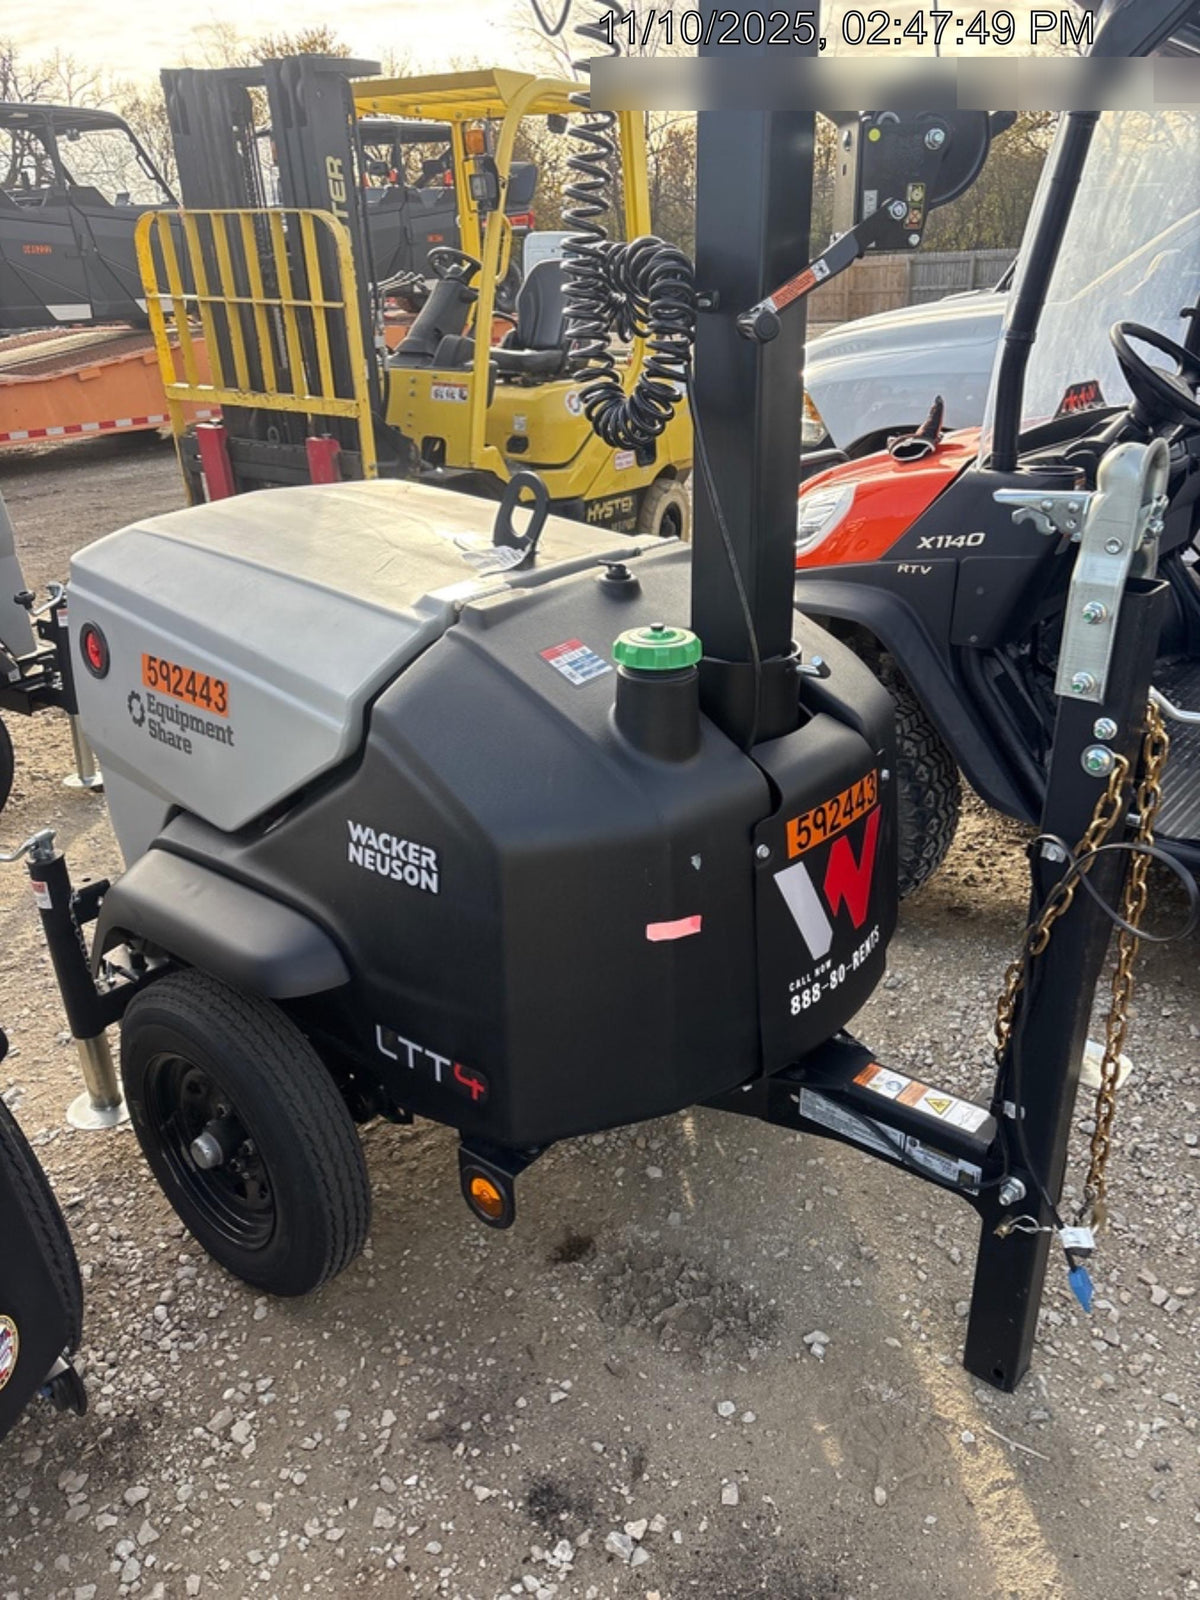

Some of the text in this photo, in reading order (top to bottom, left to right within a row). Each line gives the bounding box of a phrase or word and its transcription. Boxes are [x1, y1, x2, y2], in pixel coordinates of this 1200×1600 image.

[326, 155, 350, 232] TER
[916, 532, 986, 549] X1140
[897, 563, 932, 575] RTV
[147, 655, 227, 713] 592443
[146, 692, 235, 747] Equipment
[148, 718, 193, 755] Share
[796, 773, 876, 849] 592443
[347, 819, 438, 872] WACKER
[348, 842, 438, 894] NEUSON
[789, 959, 832, 992] CALL NOW
[790, 924, 880, 1016] 888-80-RENTS
[376, 1024, 485, 1100] LTT4
